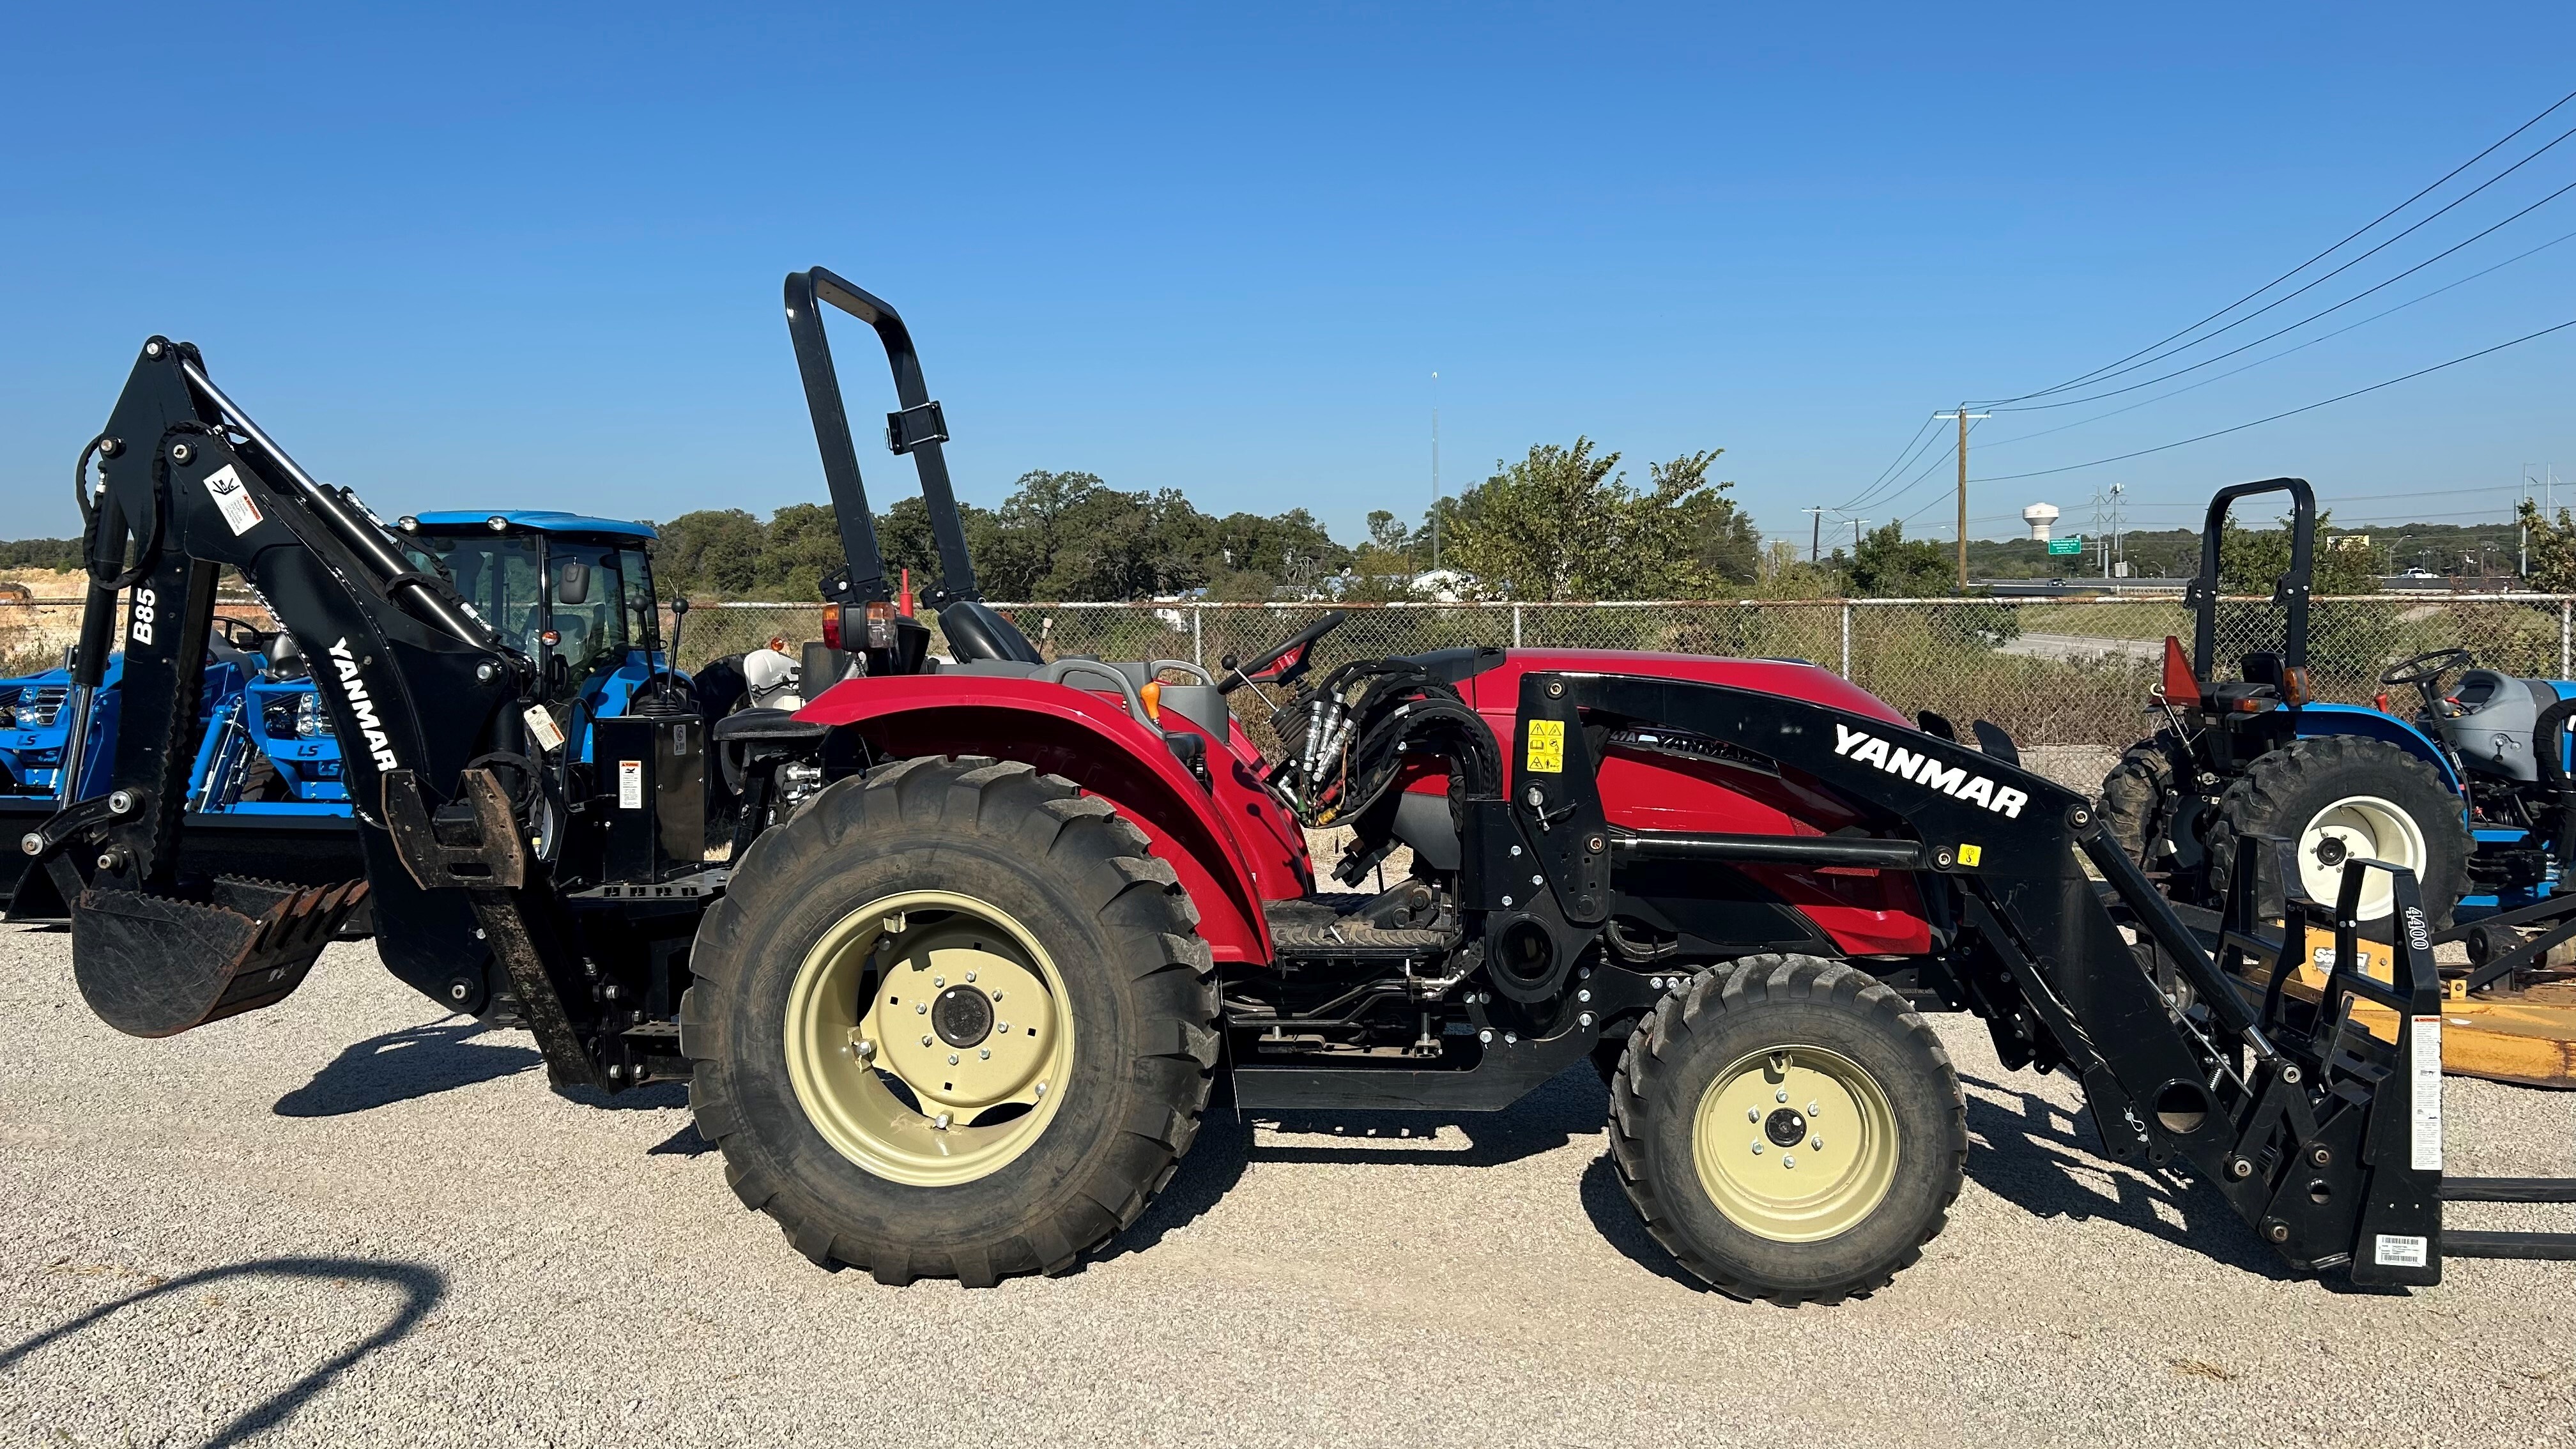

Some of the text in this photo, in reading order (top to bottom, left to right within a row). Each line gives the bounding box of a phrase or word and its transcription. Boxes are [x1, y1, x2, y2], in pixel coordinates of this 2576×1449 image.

[133, 588, 155, 645] B85
[329, 636, 397, 771] YANMAR
[16, 734, 40, 746] LS
[297, 744, 323, 757] LS
[318, 762, 340, 776] LS
[1834, 723, 2028, 819] YANMAR
[2405, 907, 2429, 950] 4400
